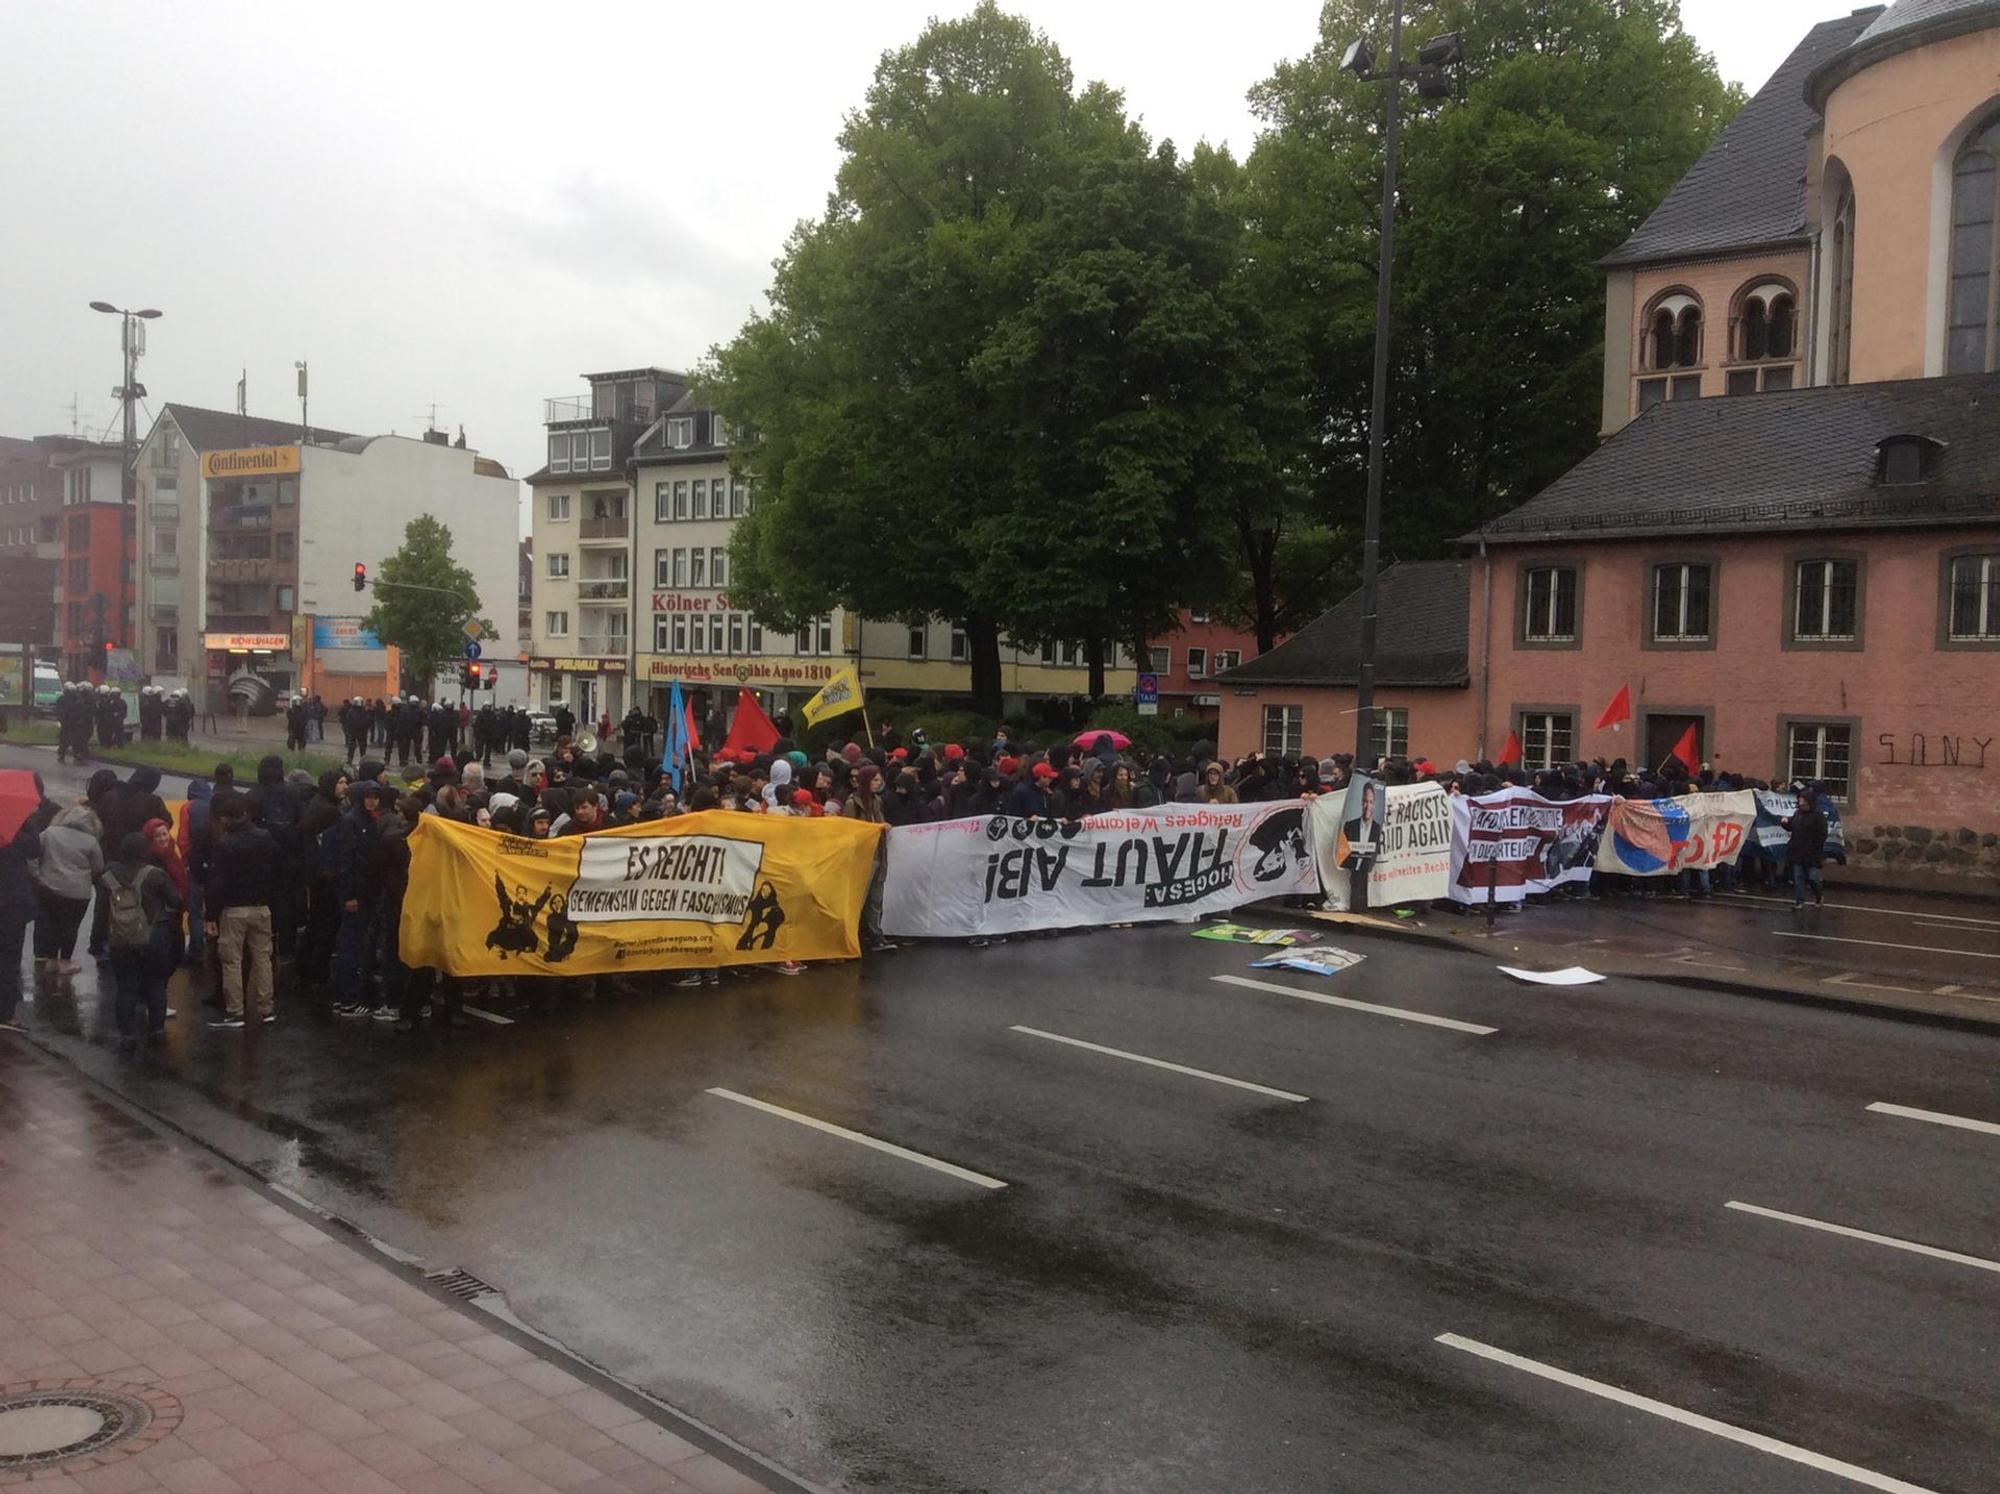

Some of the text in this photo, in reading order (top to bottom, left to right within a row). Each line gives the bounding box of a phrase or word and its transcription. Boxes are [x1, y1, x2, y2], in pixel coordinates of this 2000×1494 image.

[208, 450, 278, 475] Continental
[652, 593, 712, 612] Kölner
[652, 661, 832, 681] Historische Senfühle Anno 1810
[1879, 733, 1992, 767] SONY
[1165, 811, 1244, 829] Refugees
[1395, 794, 1449, 825] RACISTS
[1408, 819, 1451, 849] AGAIN
[624, 843, 727, 885] ES REICHT!
[984, 829, 1228, 904] HAUT AB!
[570, 888, 749, 916] GEMEINSAM GEGEN FASCHISMUS
